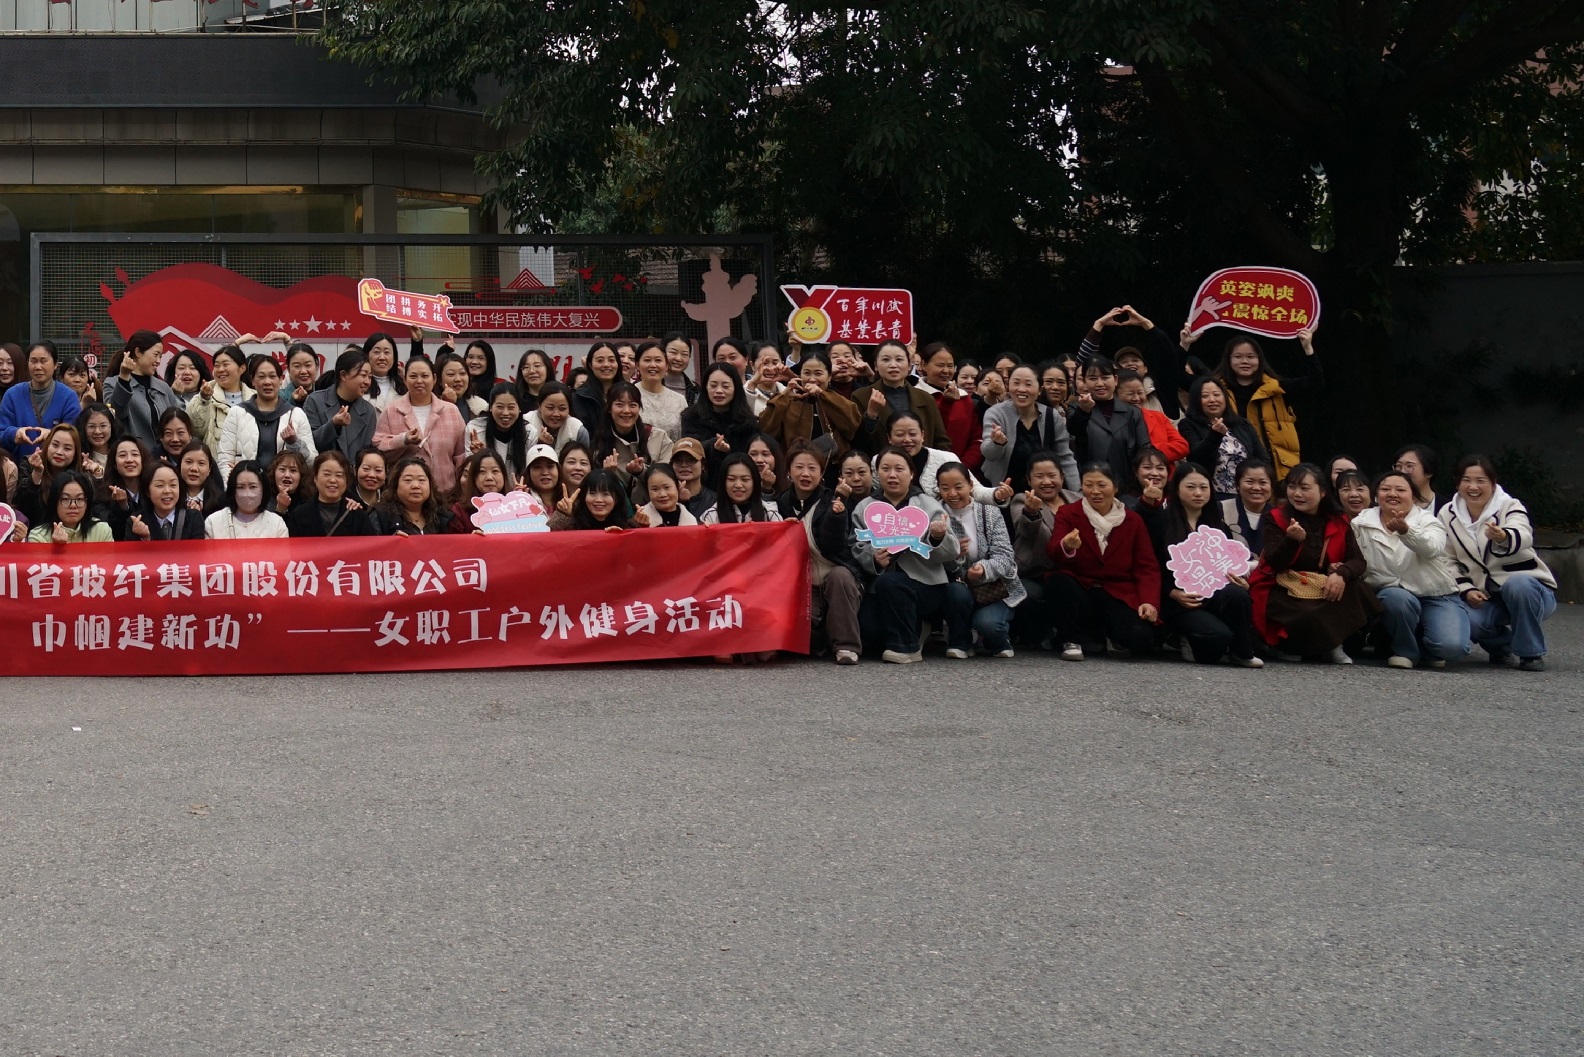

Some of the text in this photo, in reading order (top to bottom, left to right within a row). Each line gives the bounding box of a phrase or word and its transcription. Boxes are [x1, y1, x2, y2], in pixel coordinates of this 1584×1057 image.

[1220, 280, 1295, 302] 英姿飒爽
[1232, 303, 1308, 325] 震惊全场
[885, 513, 909, 527] 自信
